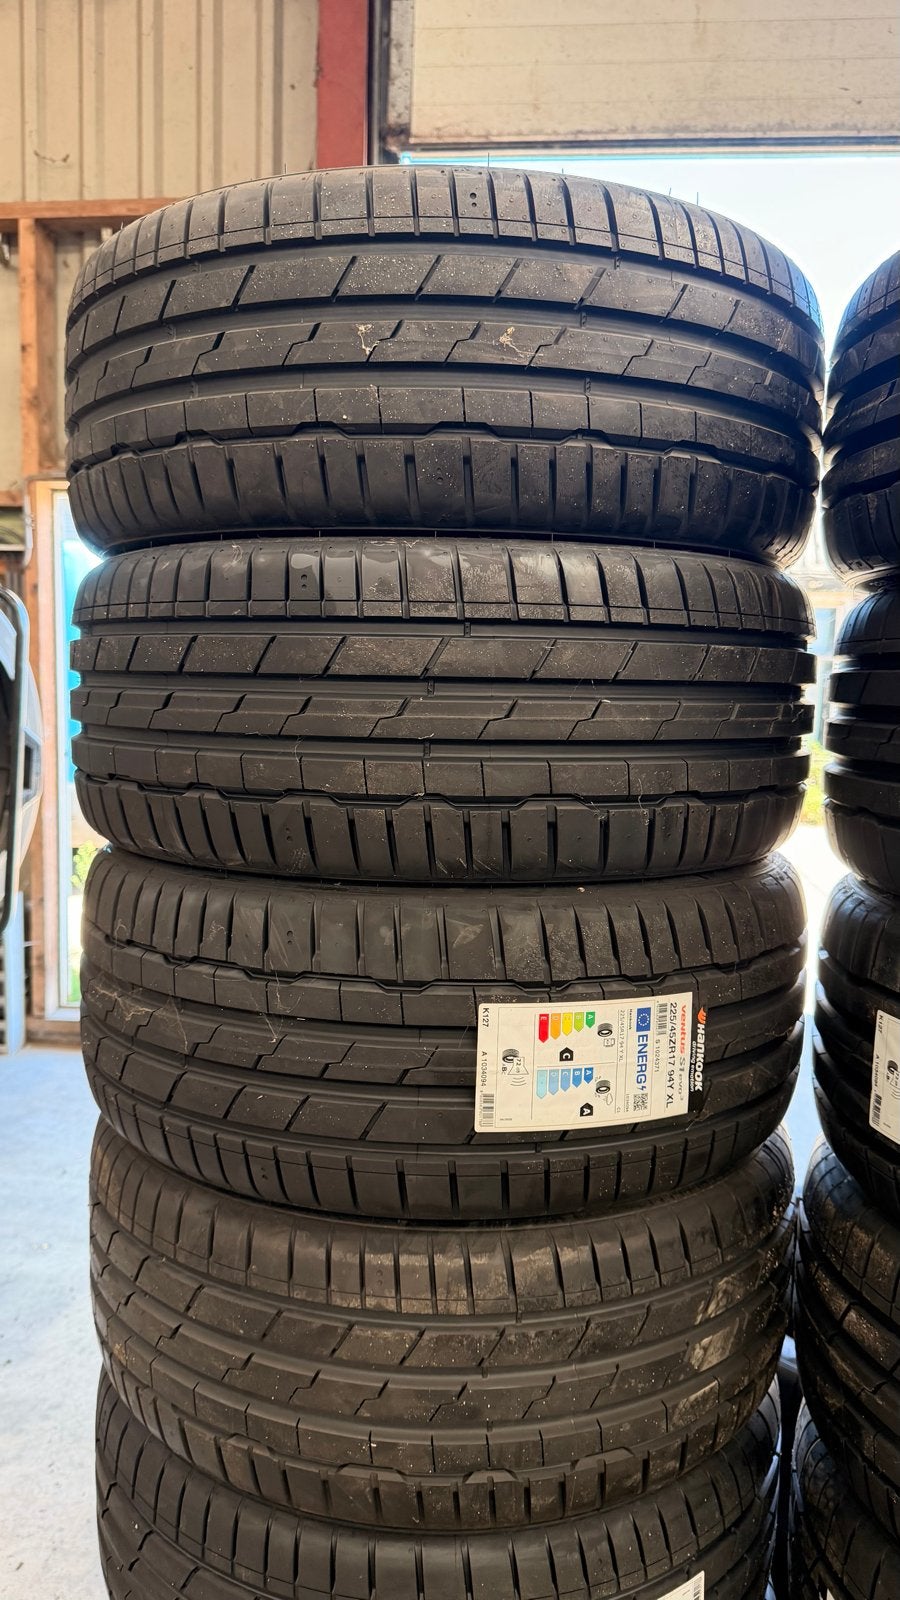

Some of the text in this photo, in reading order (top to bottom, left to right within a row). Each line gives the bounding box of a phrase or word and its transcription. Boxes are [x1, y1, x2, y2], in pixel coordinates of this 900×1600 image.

[482, 1007, 490, 1028] K127
[514, 1058, 522, 1067] 72
[665, 1002, 678, 1109] 225/45ZR17 94Y XL
[480, 1058, 488, 1087] 1034094
